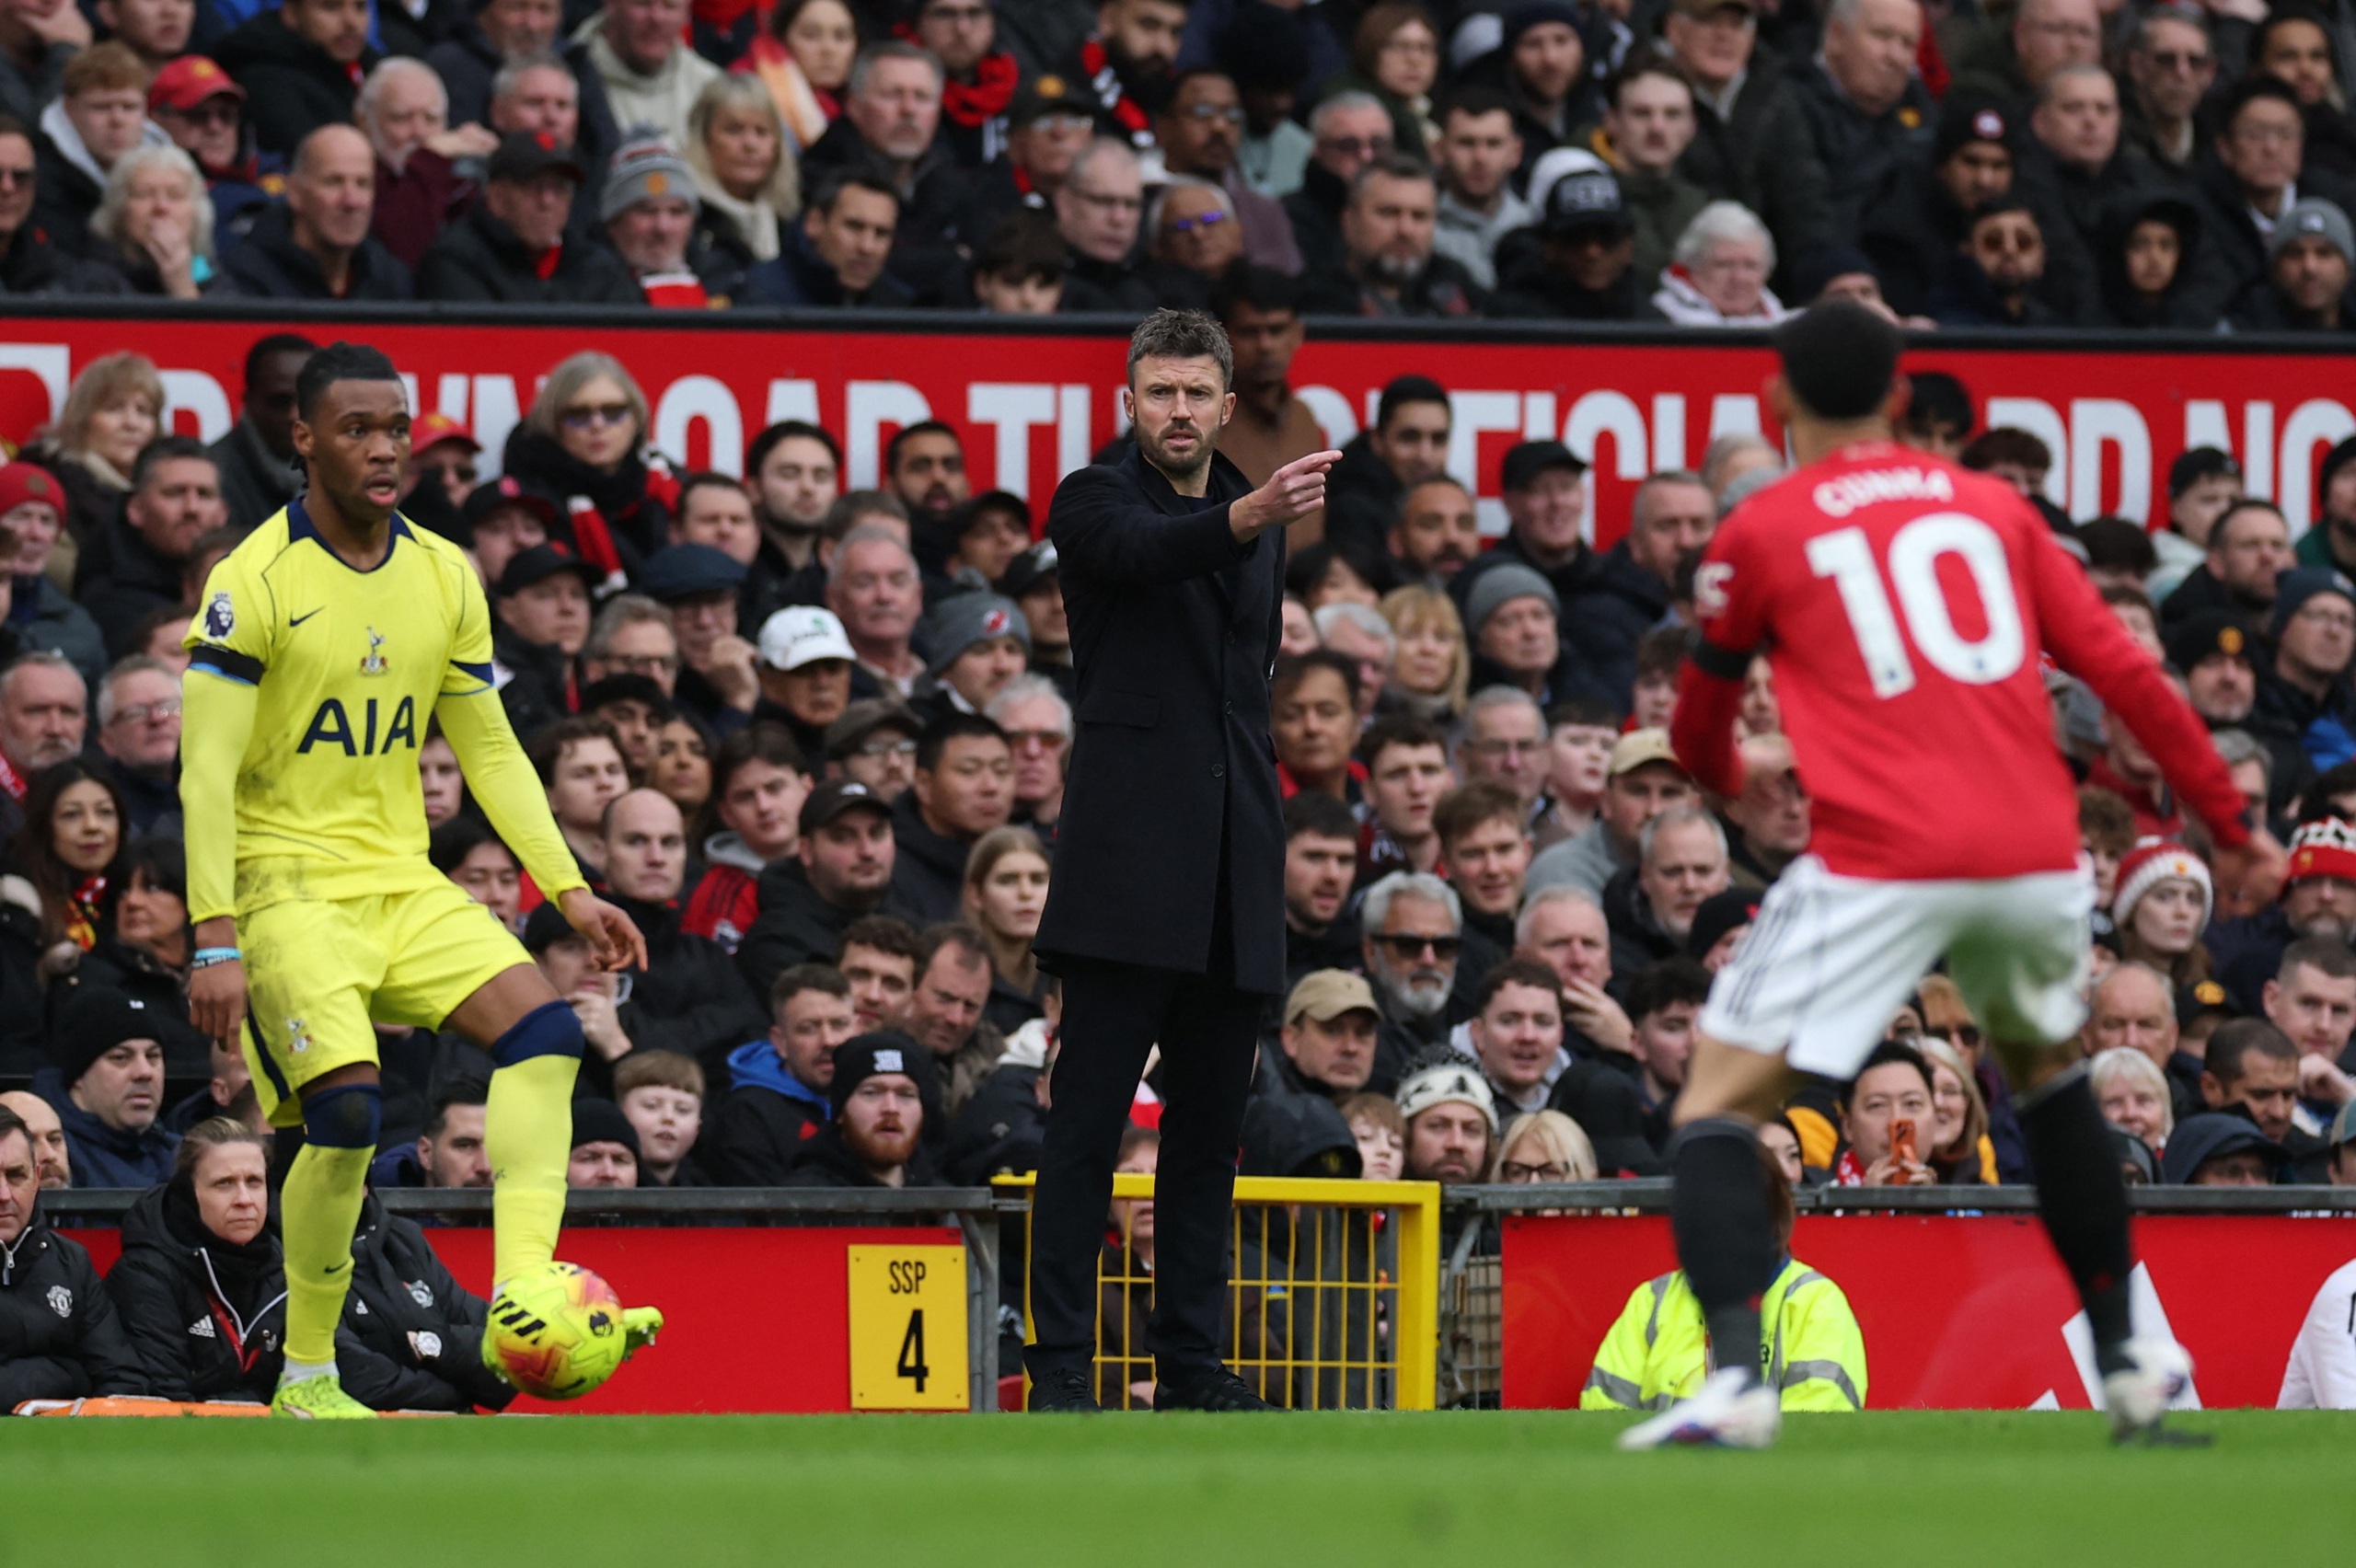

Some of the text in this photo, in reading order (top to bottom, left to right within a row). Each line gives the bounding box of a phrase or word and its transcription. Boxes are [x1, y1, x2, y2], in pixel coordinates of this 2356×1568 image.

[1805, 512, 2026, 700] 10
[296, 696, 416, 756] AIA
[889, 1261, 926, 1294] SSP
[897, 1309, 929, 1393] 4
